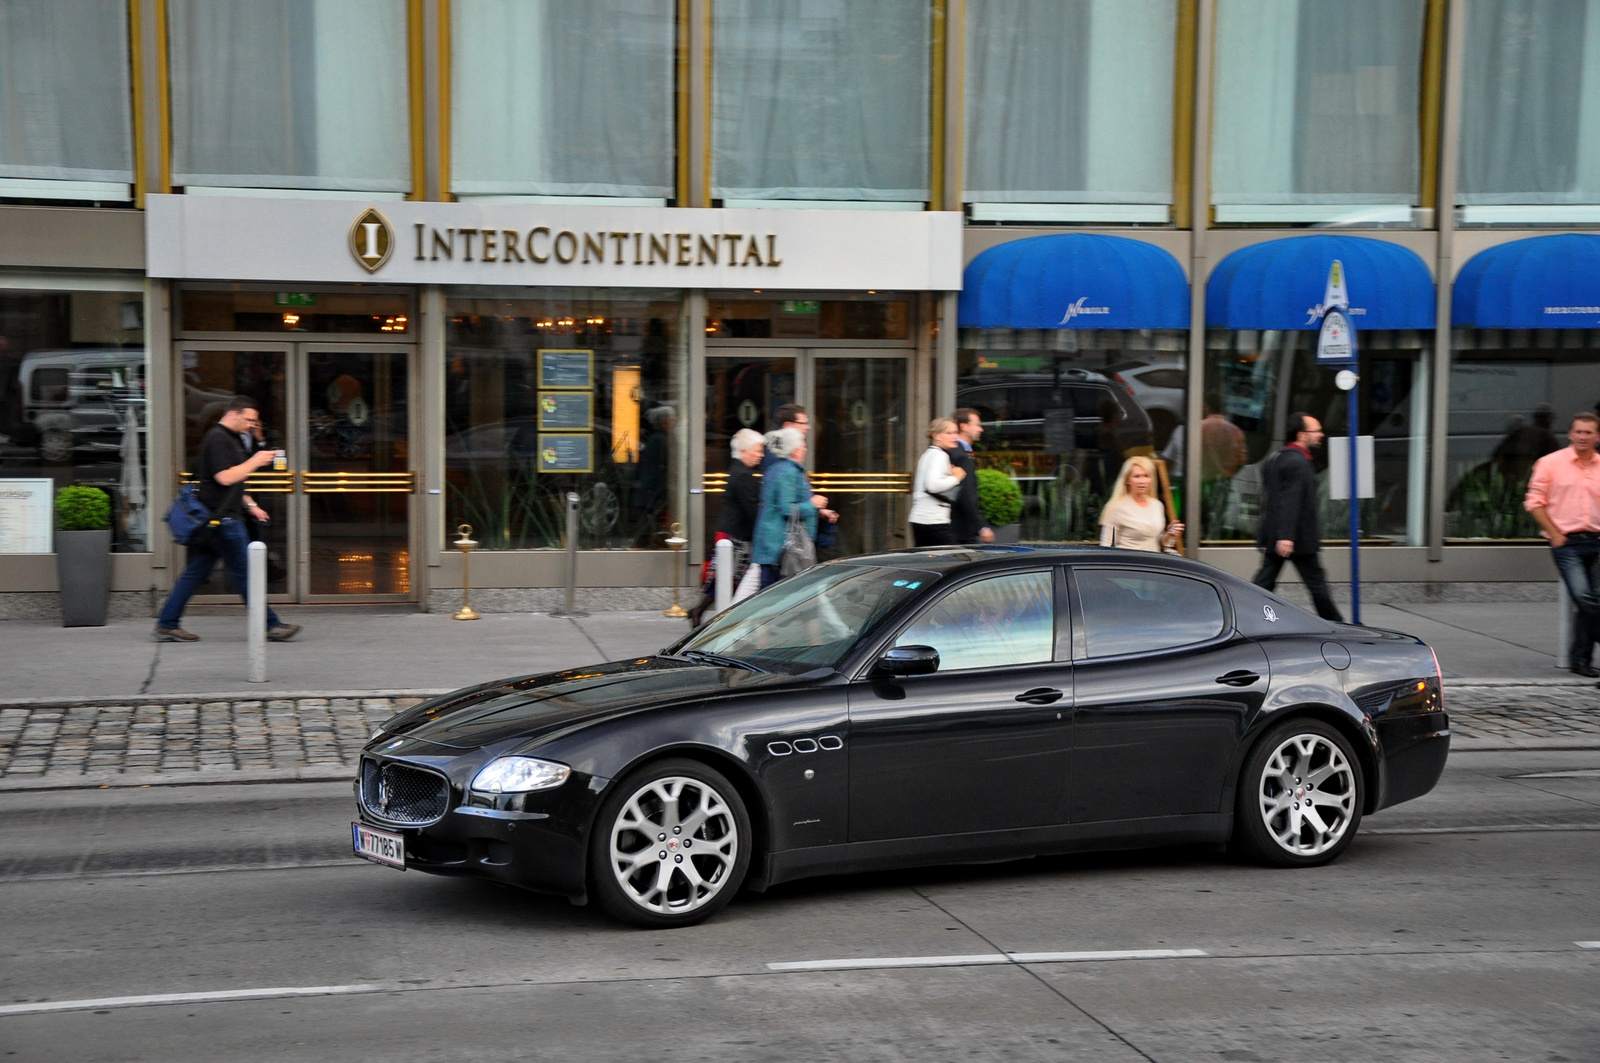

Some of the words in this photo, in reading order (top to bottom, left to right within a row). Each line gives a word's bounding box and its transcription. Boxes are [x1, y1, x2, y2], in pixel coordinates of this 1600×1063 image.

[413, 222, 782, 268] INTERCONTINENTAL
[370, 833, 394, 857] 77185
[395, 840, 402, 860] W
